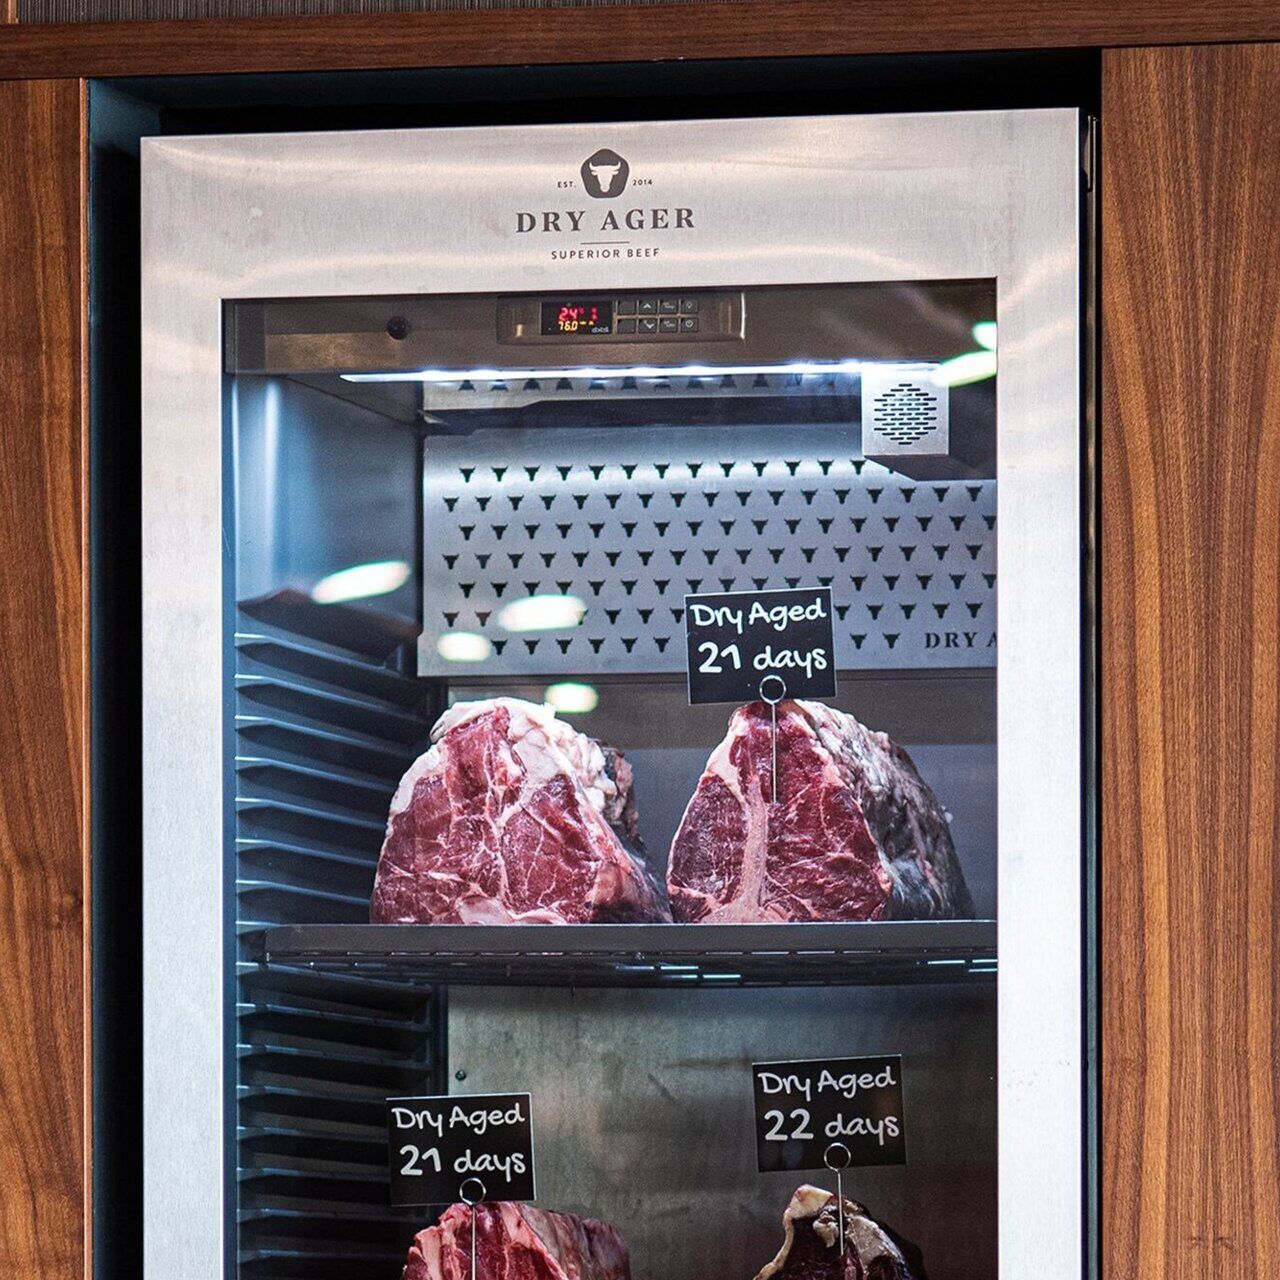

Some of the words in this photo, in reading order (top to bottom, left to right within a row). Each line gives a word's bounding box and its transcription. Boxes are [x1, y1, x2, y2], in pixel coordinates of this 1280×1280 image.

[517, 211, 585, 232] DRY
[601, 209, 694, 230] AGER
[551, 250, 619, 259] SUPERIOR
[628, 248, 658, 257] BEEF
[690, 605, 742, 634] Dry
[749, 598, 826, 631] Aged
[926, 632, 977, 648] DRY
[699, 642, 740, 672] 21
[753, 645, 827, 678] days
[758, 1073, 810, 1101] Dry
[818, 1066, 896, 1098] Aged
[392, 1108, 442, 1137] Dry
[450, 1103, 525, 1134] Aged
[765, 1109, 813, 1140] 22
[824, 1112, 899, 1145] days
[400, 1145, 441, 1175] 21
[453, 1150, 526, 1182] days
